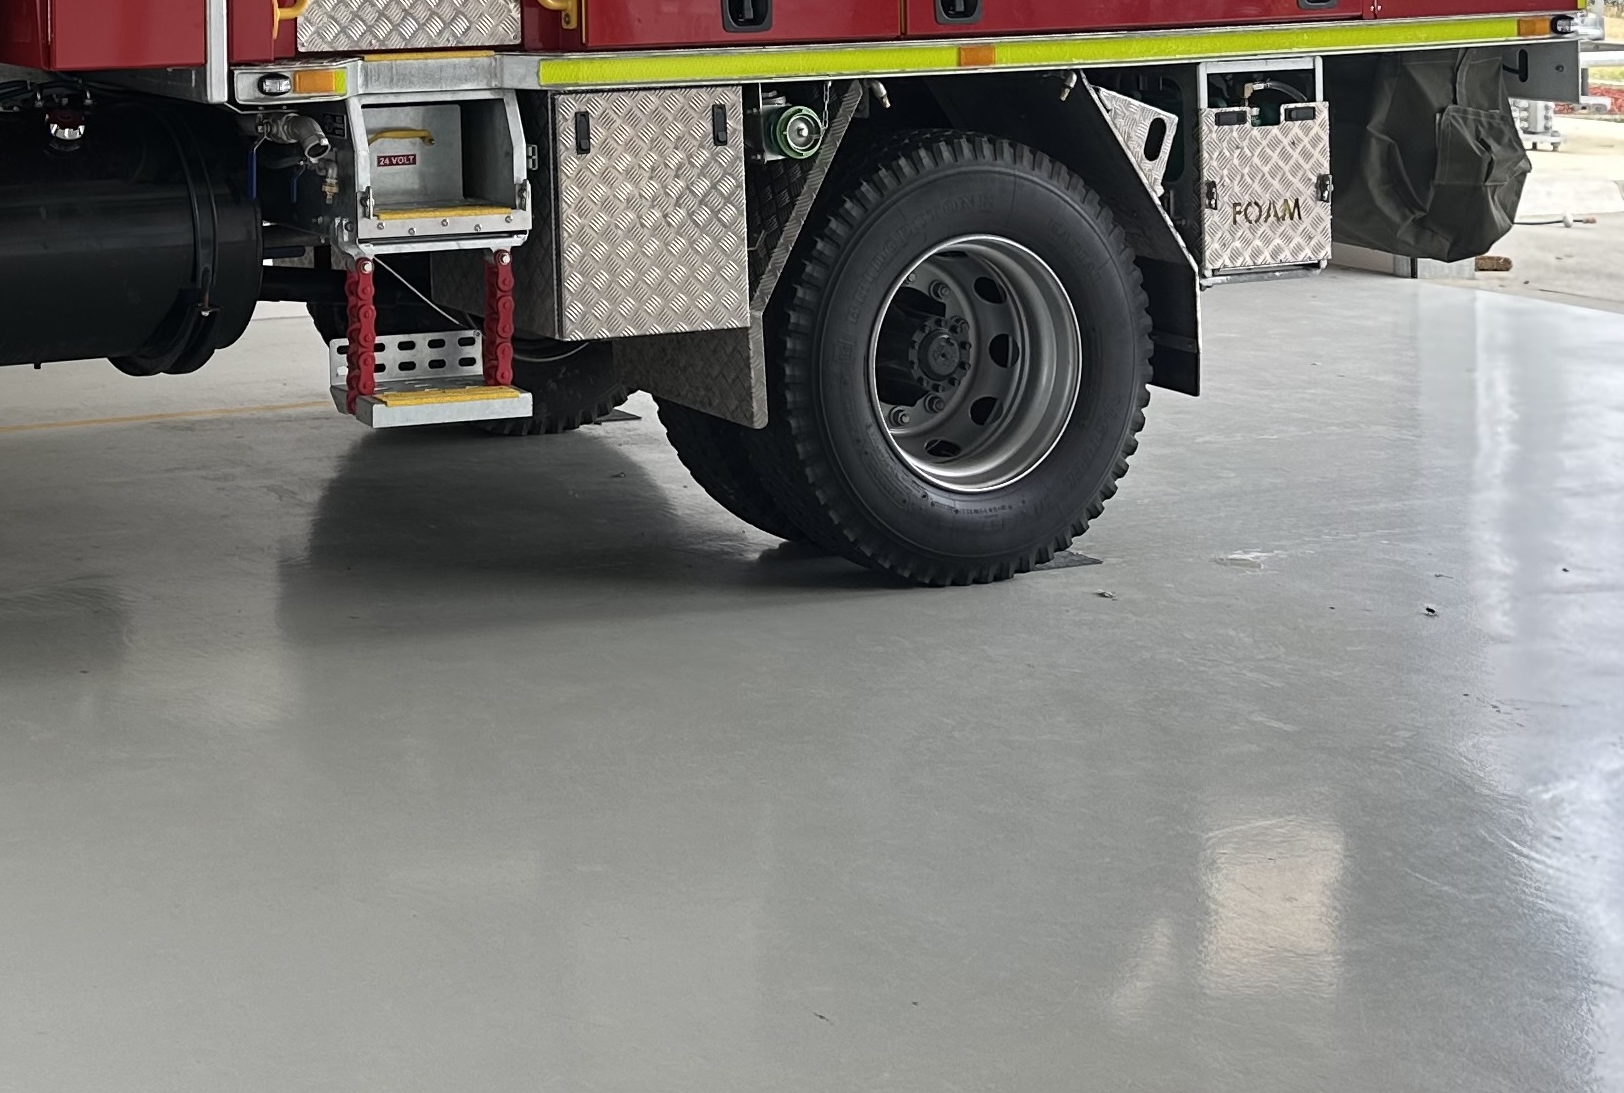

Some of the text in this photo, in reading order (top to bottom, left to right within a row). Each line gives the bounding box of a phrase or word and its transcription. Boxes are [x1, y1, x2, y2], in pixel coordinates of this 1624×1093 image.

[379, 155, 414, 165] 24 VOLT
[1232, 197, 1302, 225] FOAM
